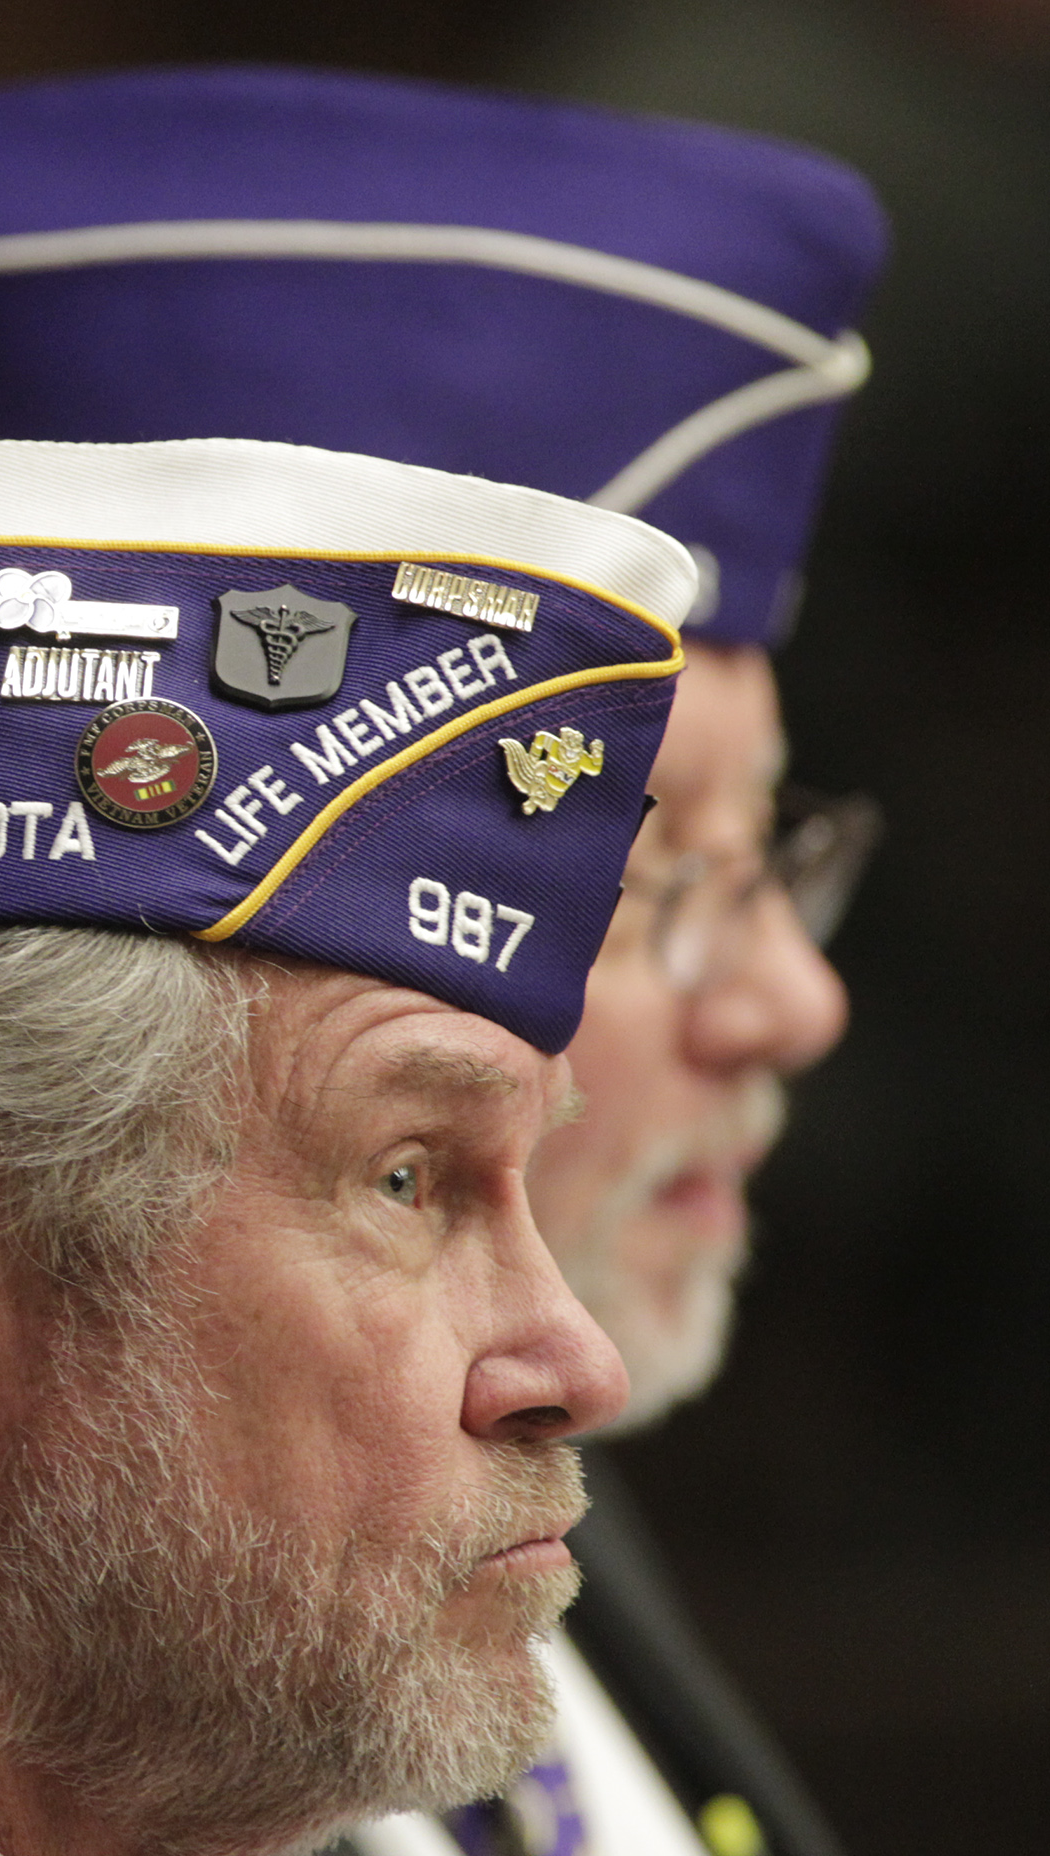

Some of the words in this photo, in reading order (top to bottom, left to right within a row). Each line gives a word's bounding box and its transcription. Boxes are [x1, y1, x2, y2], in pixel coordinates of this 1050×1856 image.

[391, 562, 540, 632] CORPSMAN
[0, 647, 161, 701] ADJUTANT
[102, 700, 196, 727] CORPSMAN
[194, 764, 304, 866] LIFE
[290, 633, 518, 785] MEMBER
[87, 782, 159, 824] VIETNAM
[165, 751, 212, 819] VETERAN
[408, 877, 535, 972] 987
